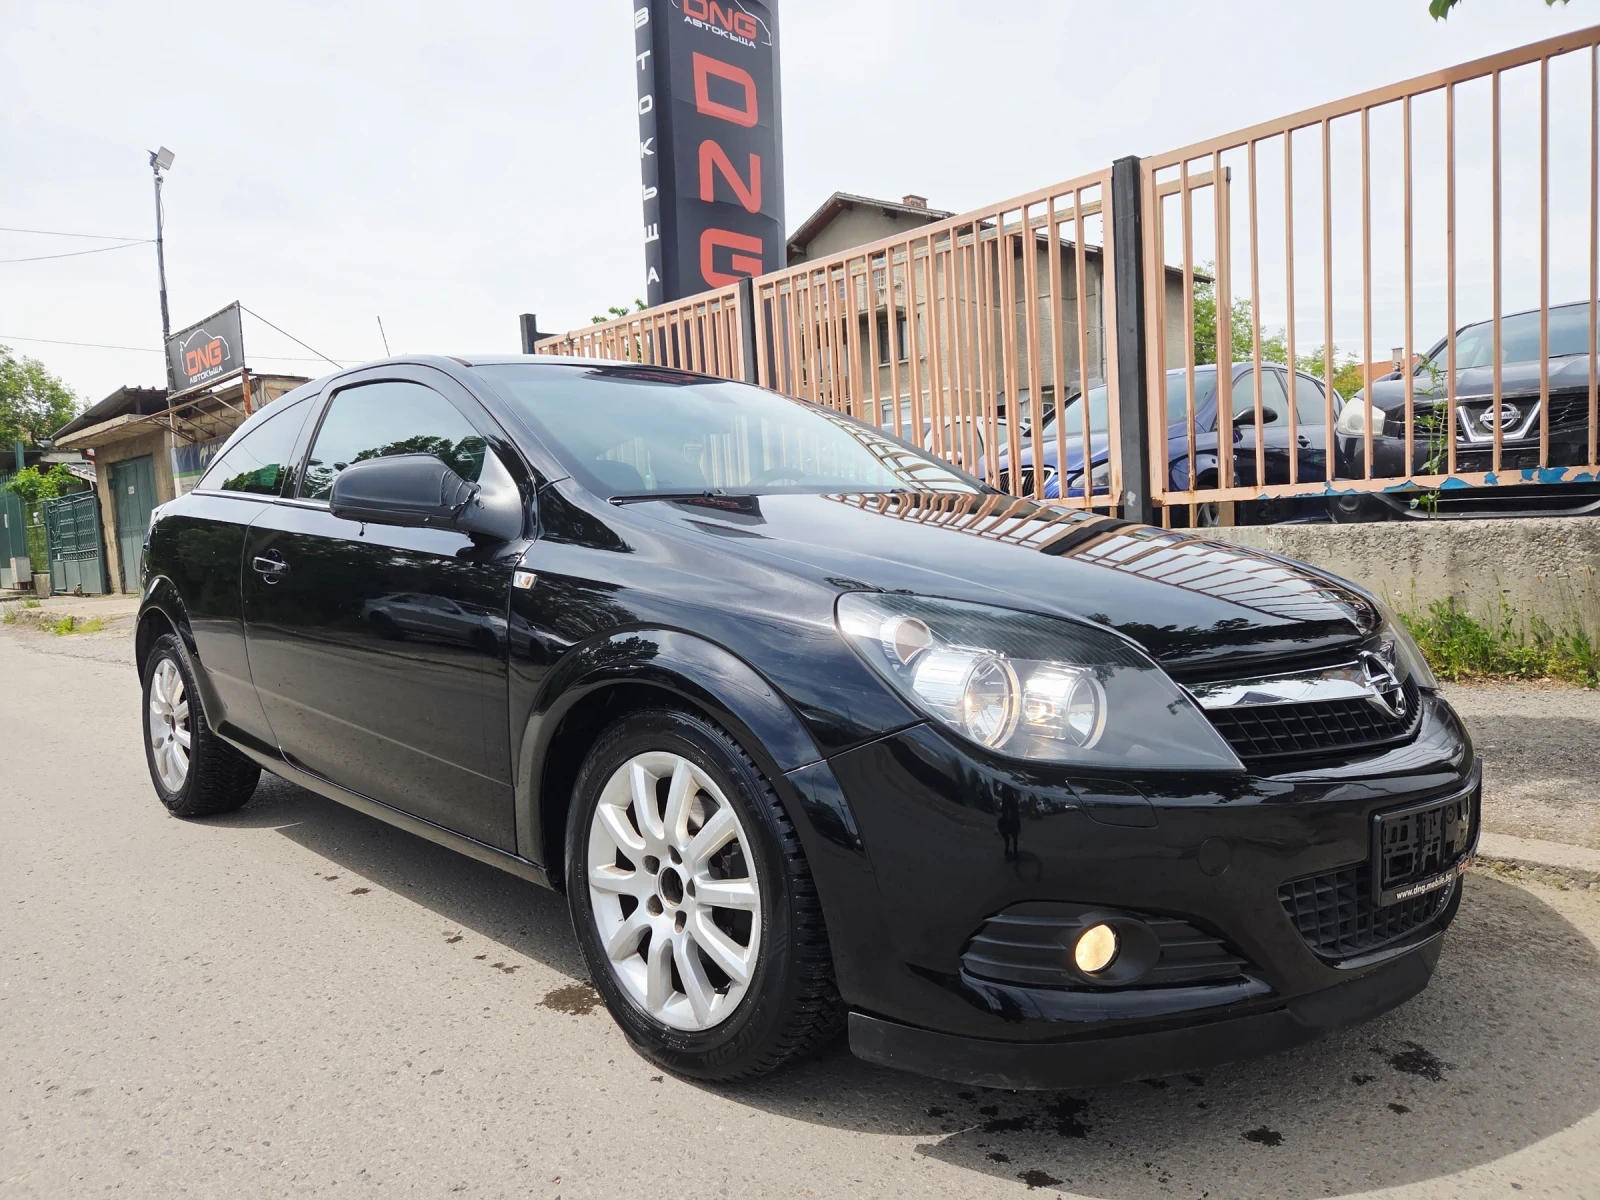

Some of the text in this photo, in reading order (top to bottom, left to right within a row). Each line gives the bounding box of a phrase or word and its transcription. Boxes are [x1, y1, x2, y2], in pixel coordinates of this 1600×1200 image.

[683, 0, 756, 40] DNG
[692, 51, 762, 289] DNG
[186, 339, 222, 376] DNG
[1483, 412, 1516, 420] NIAN
